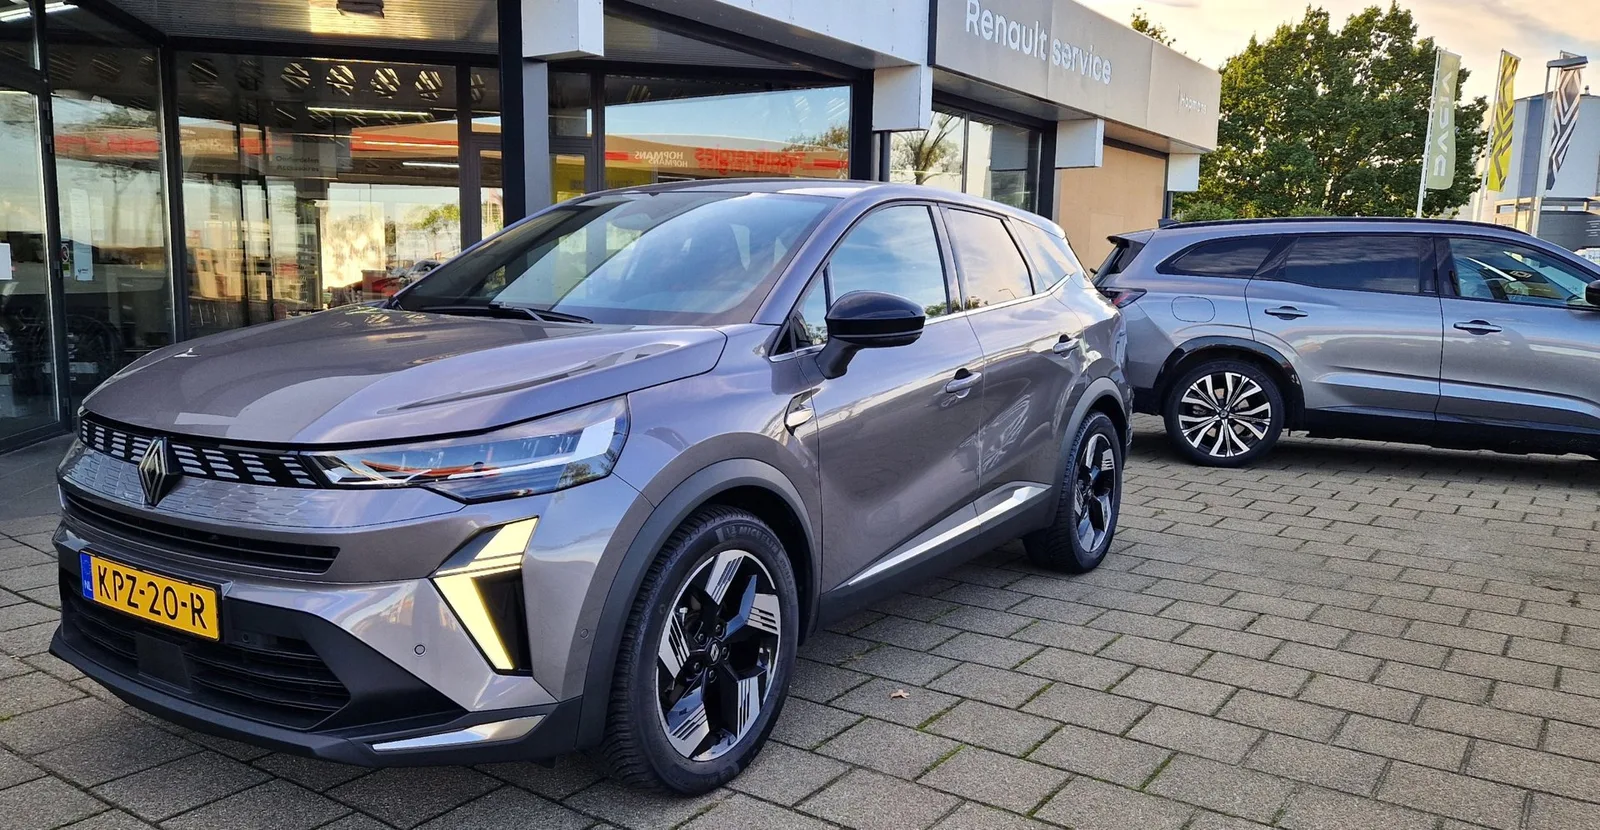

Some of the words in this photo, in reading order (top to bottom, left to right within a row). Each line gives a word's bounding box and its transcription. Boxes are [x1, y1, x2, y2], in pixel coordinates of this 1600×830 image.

[966, 0, 1048, 61] Renault
[1052, 38, 1112, 84] service
[1433, 72, 1452, 176] DACIA
[84, 580, 93, 591] NL
[97, 565, 208, 630] KPZ-20-R
